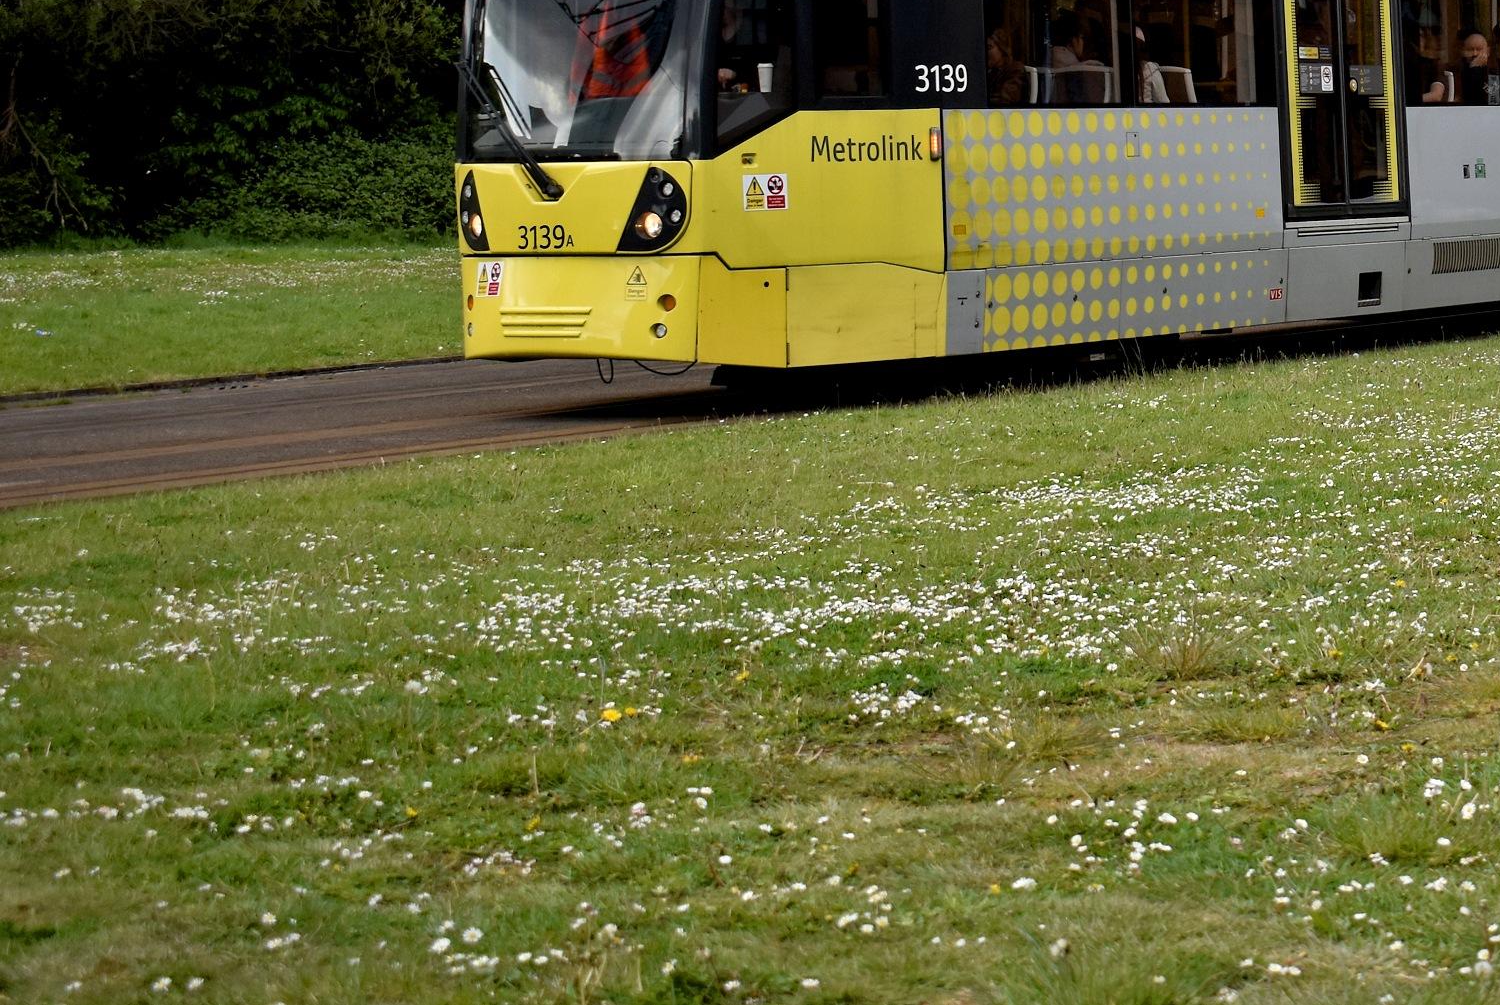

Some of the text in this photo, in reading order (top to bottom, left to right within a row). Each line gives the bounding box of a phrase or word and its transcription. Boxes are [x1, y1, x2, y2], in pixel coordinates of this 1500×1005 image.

[914, 63, 968, 93] 3139
[810, 134, 923, 163] Metrolink
[1270, 289, 1283, 299] VIS
